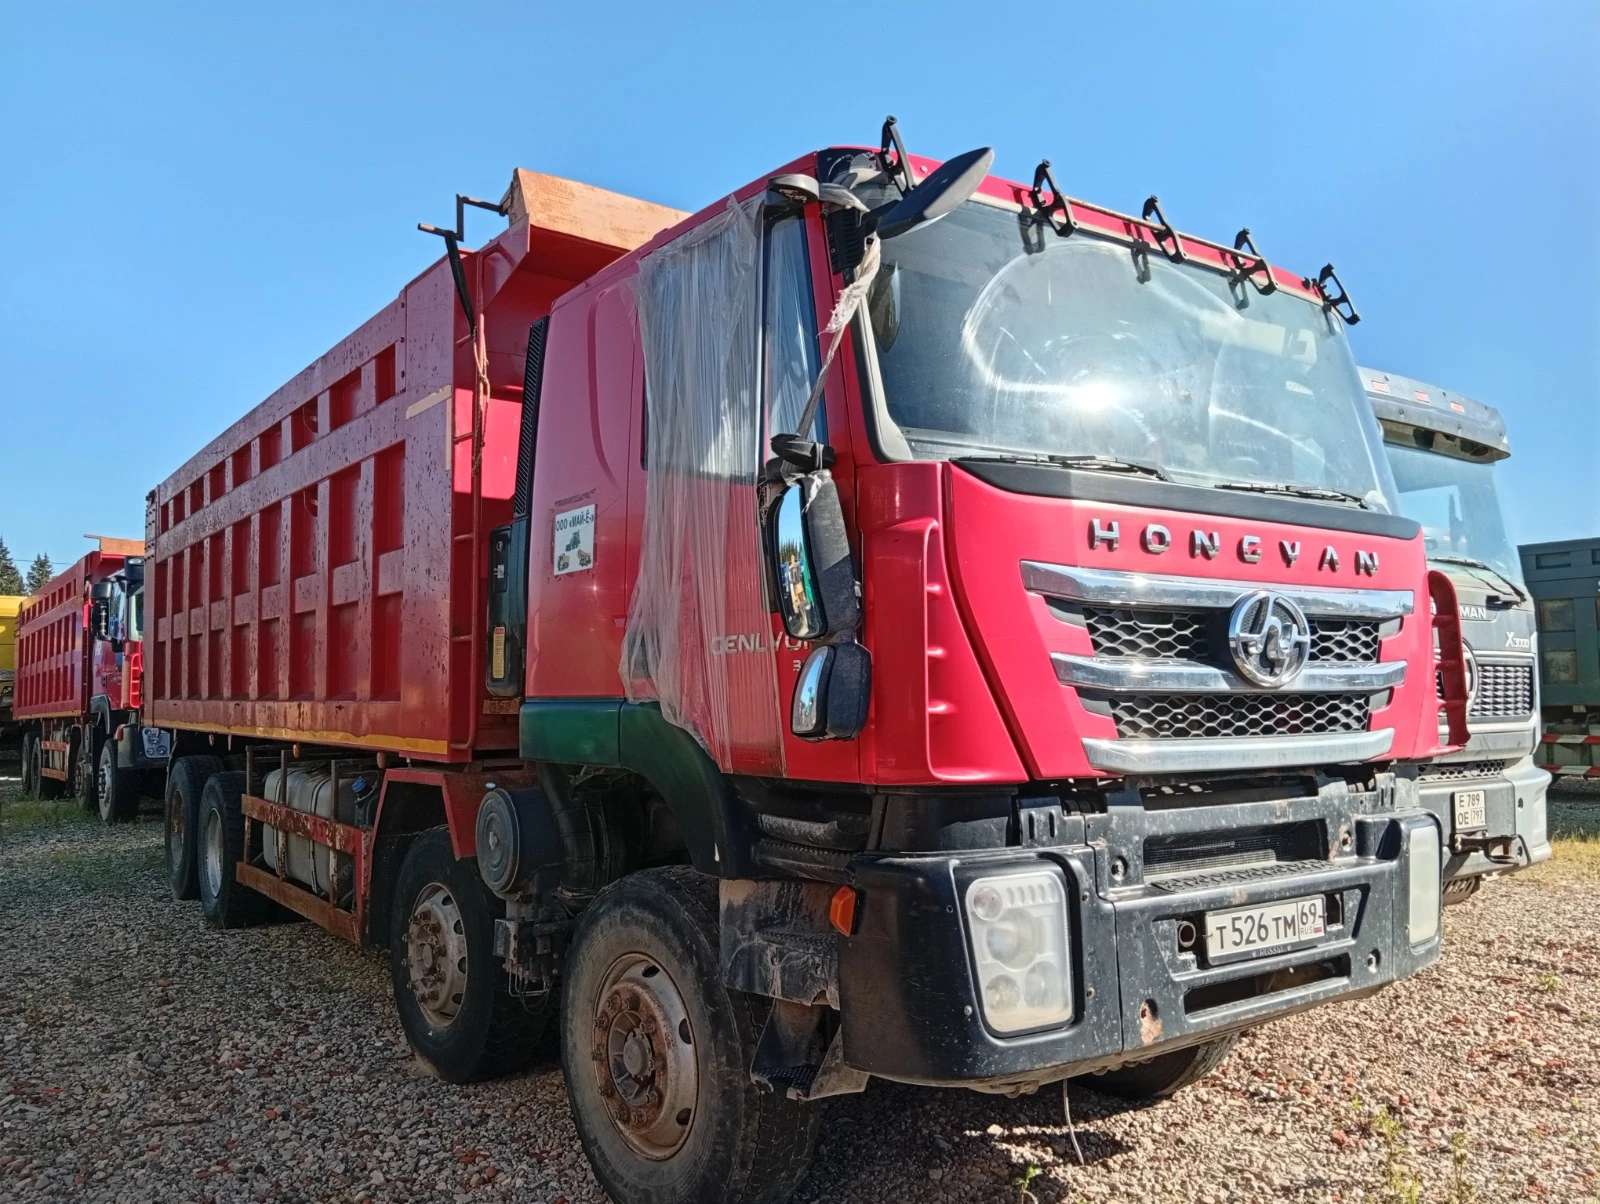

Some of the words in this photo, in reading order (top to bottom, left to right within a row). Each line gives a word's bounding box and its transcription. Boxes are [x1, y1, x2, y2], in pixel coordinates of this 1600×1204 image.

[556, 518, 568, 532] ООО
[1089, 518, 1379, 577] HONGYAN
[1300, 902, 1318, 926] 69
[1300, 926, 1313, 935] RUS
